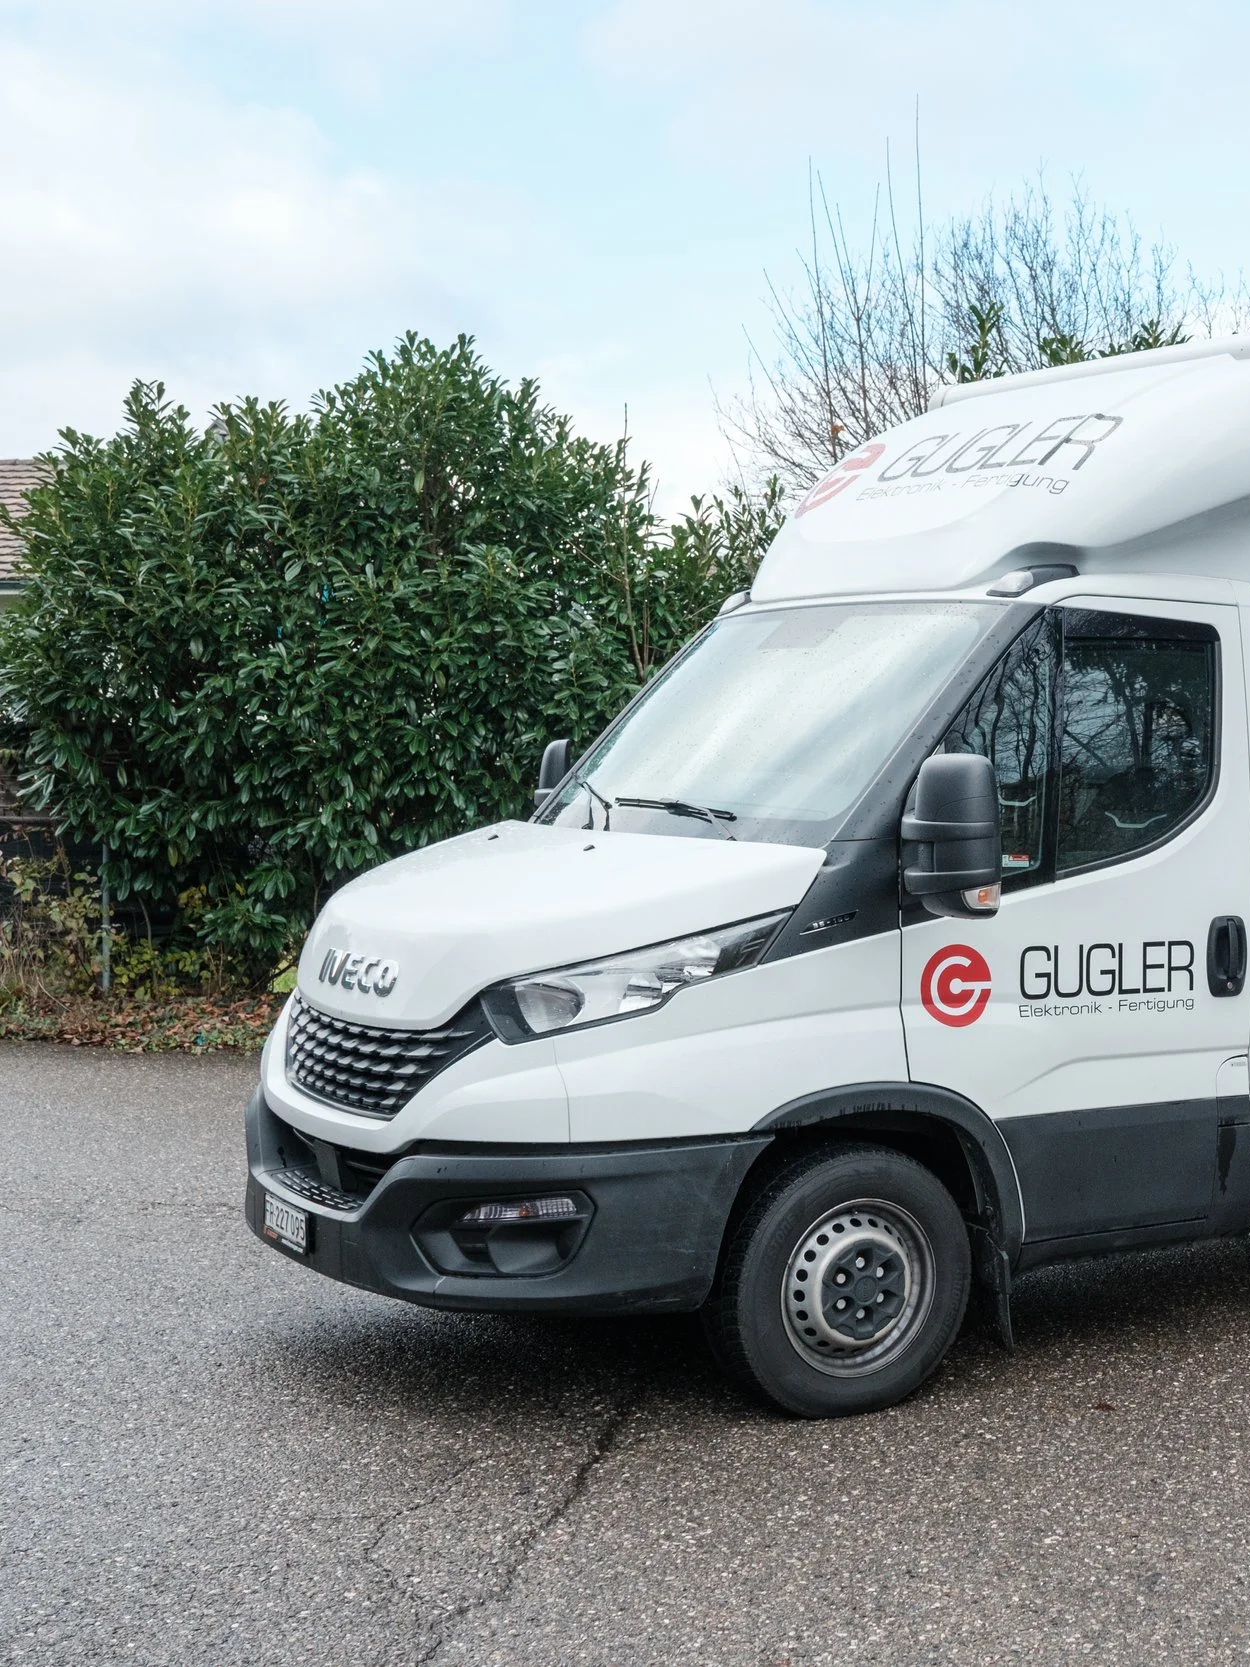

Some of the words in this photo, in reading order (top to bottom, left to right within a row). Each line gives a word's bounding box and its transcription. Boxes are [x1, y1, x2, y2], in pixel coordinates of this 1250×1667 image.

[877, 413, 1123, 483] GUGLER
[856, 478, 946, 501] Elektronik
[960, 472, 1069, 495] Fertigung
[318, 947, 400, 998] IVECO
[1019, 939, 1195, 1001] GUGLER
[1018, 1001, 1103, 1018] Elektronik
[1118, 997, 1195, 1013] Fertigung
